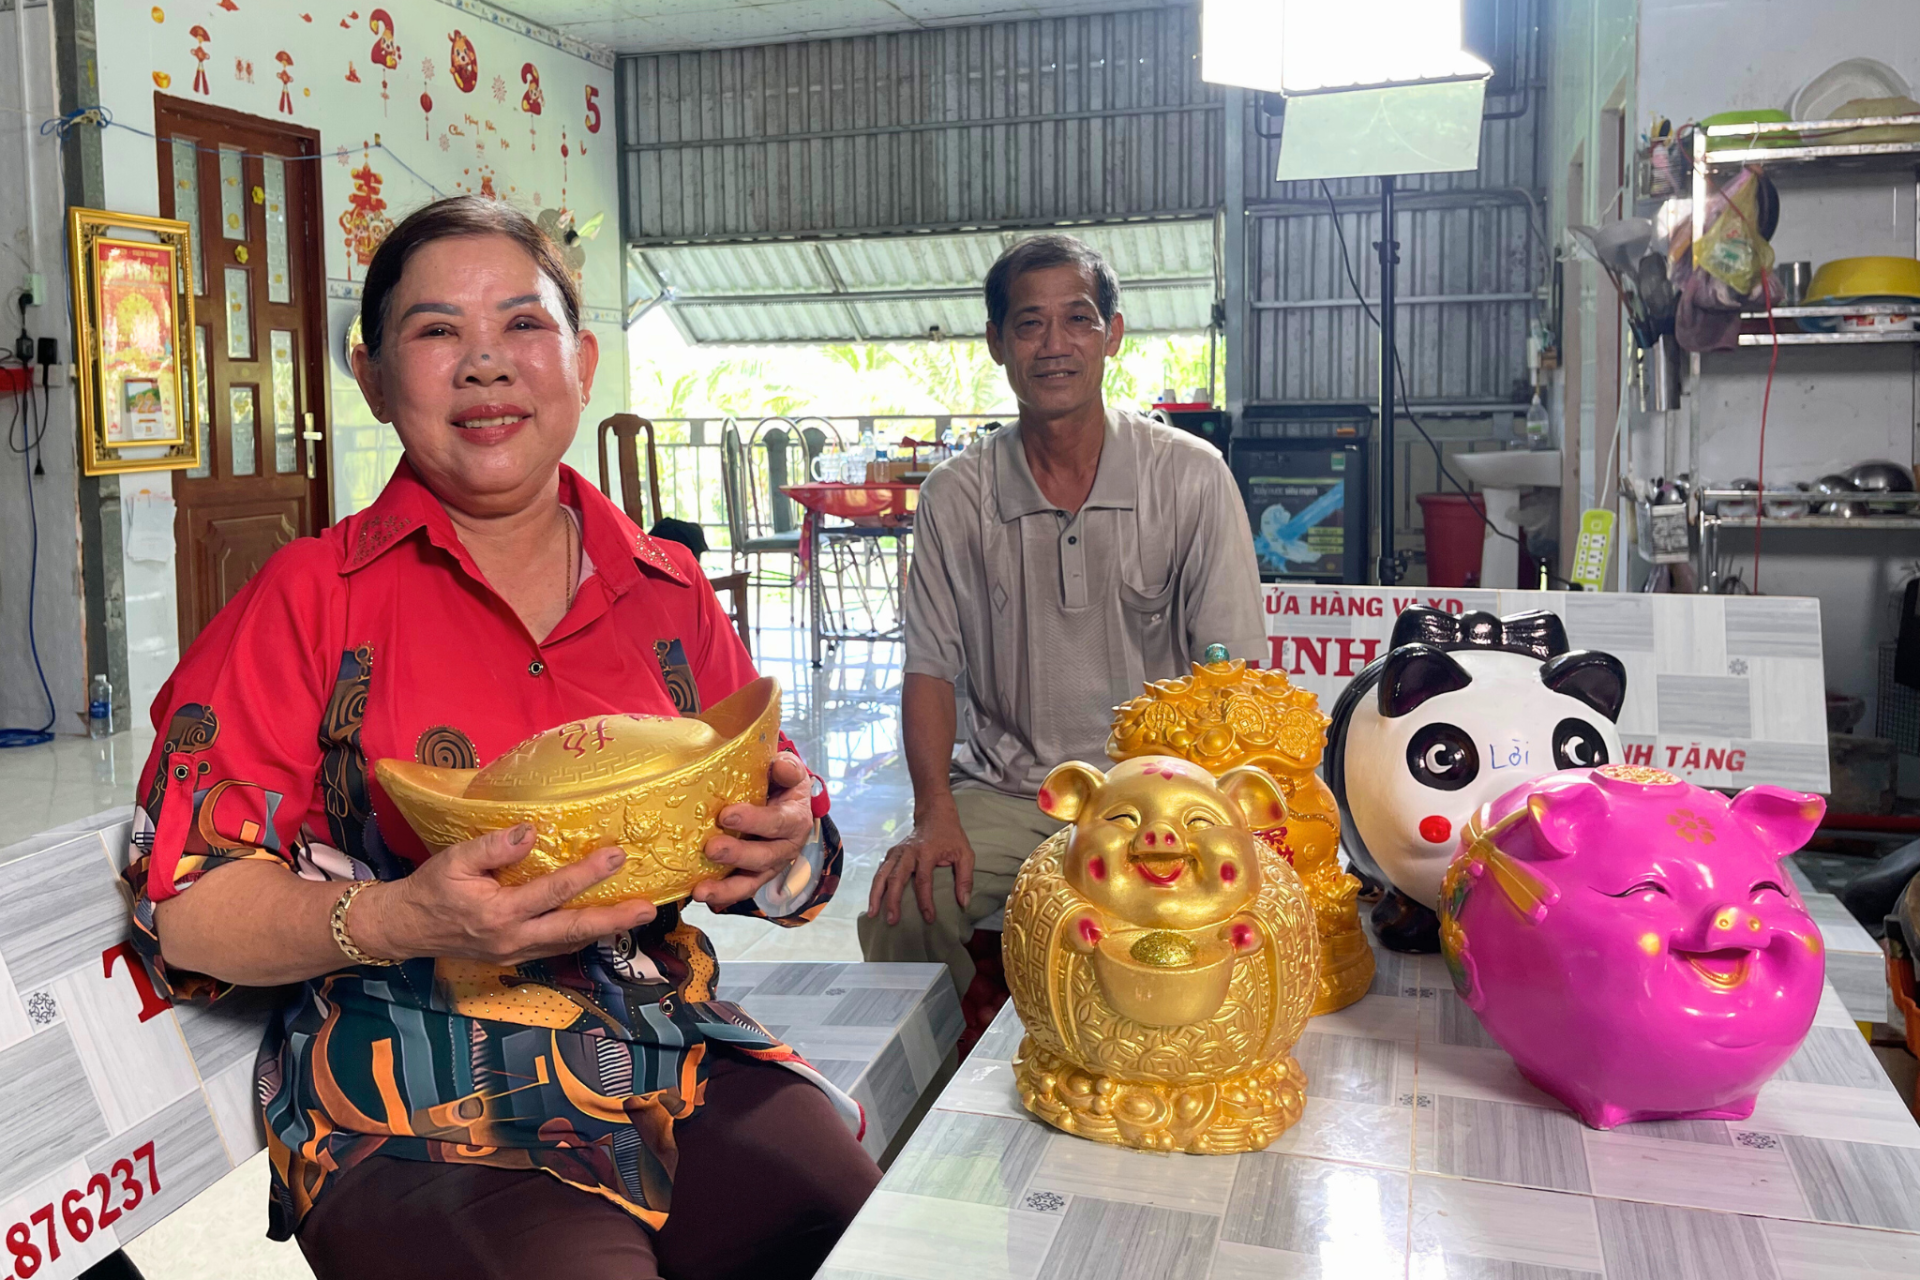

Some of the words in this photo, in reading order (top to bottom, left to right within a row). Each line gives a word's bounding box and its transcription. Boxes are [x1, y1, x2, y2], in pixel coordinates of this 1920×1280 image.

[136, 392, 156, 414] 22
[1263, 587, 1300, 615] ỬA
[1310, 590, 1383, 617] HÀNG
[1392, 597, 1464, 616] VXD
[1252, 636, 1381, 677] INH
[1665, 742, 1746, 775] TẶNG
[4, 1140, 161, 1280] 876237
